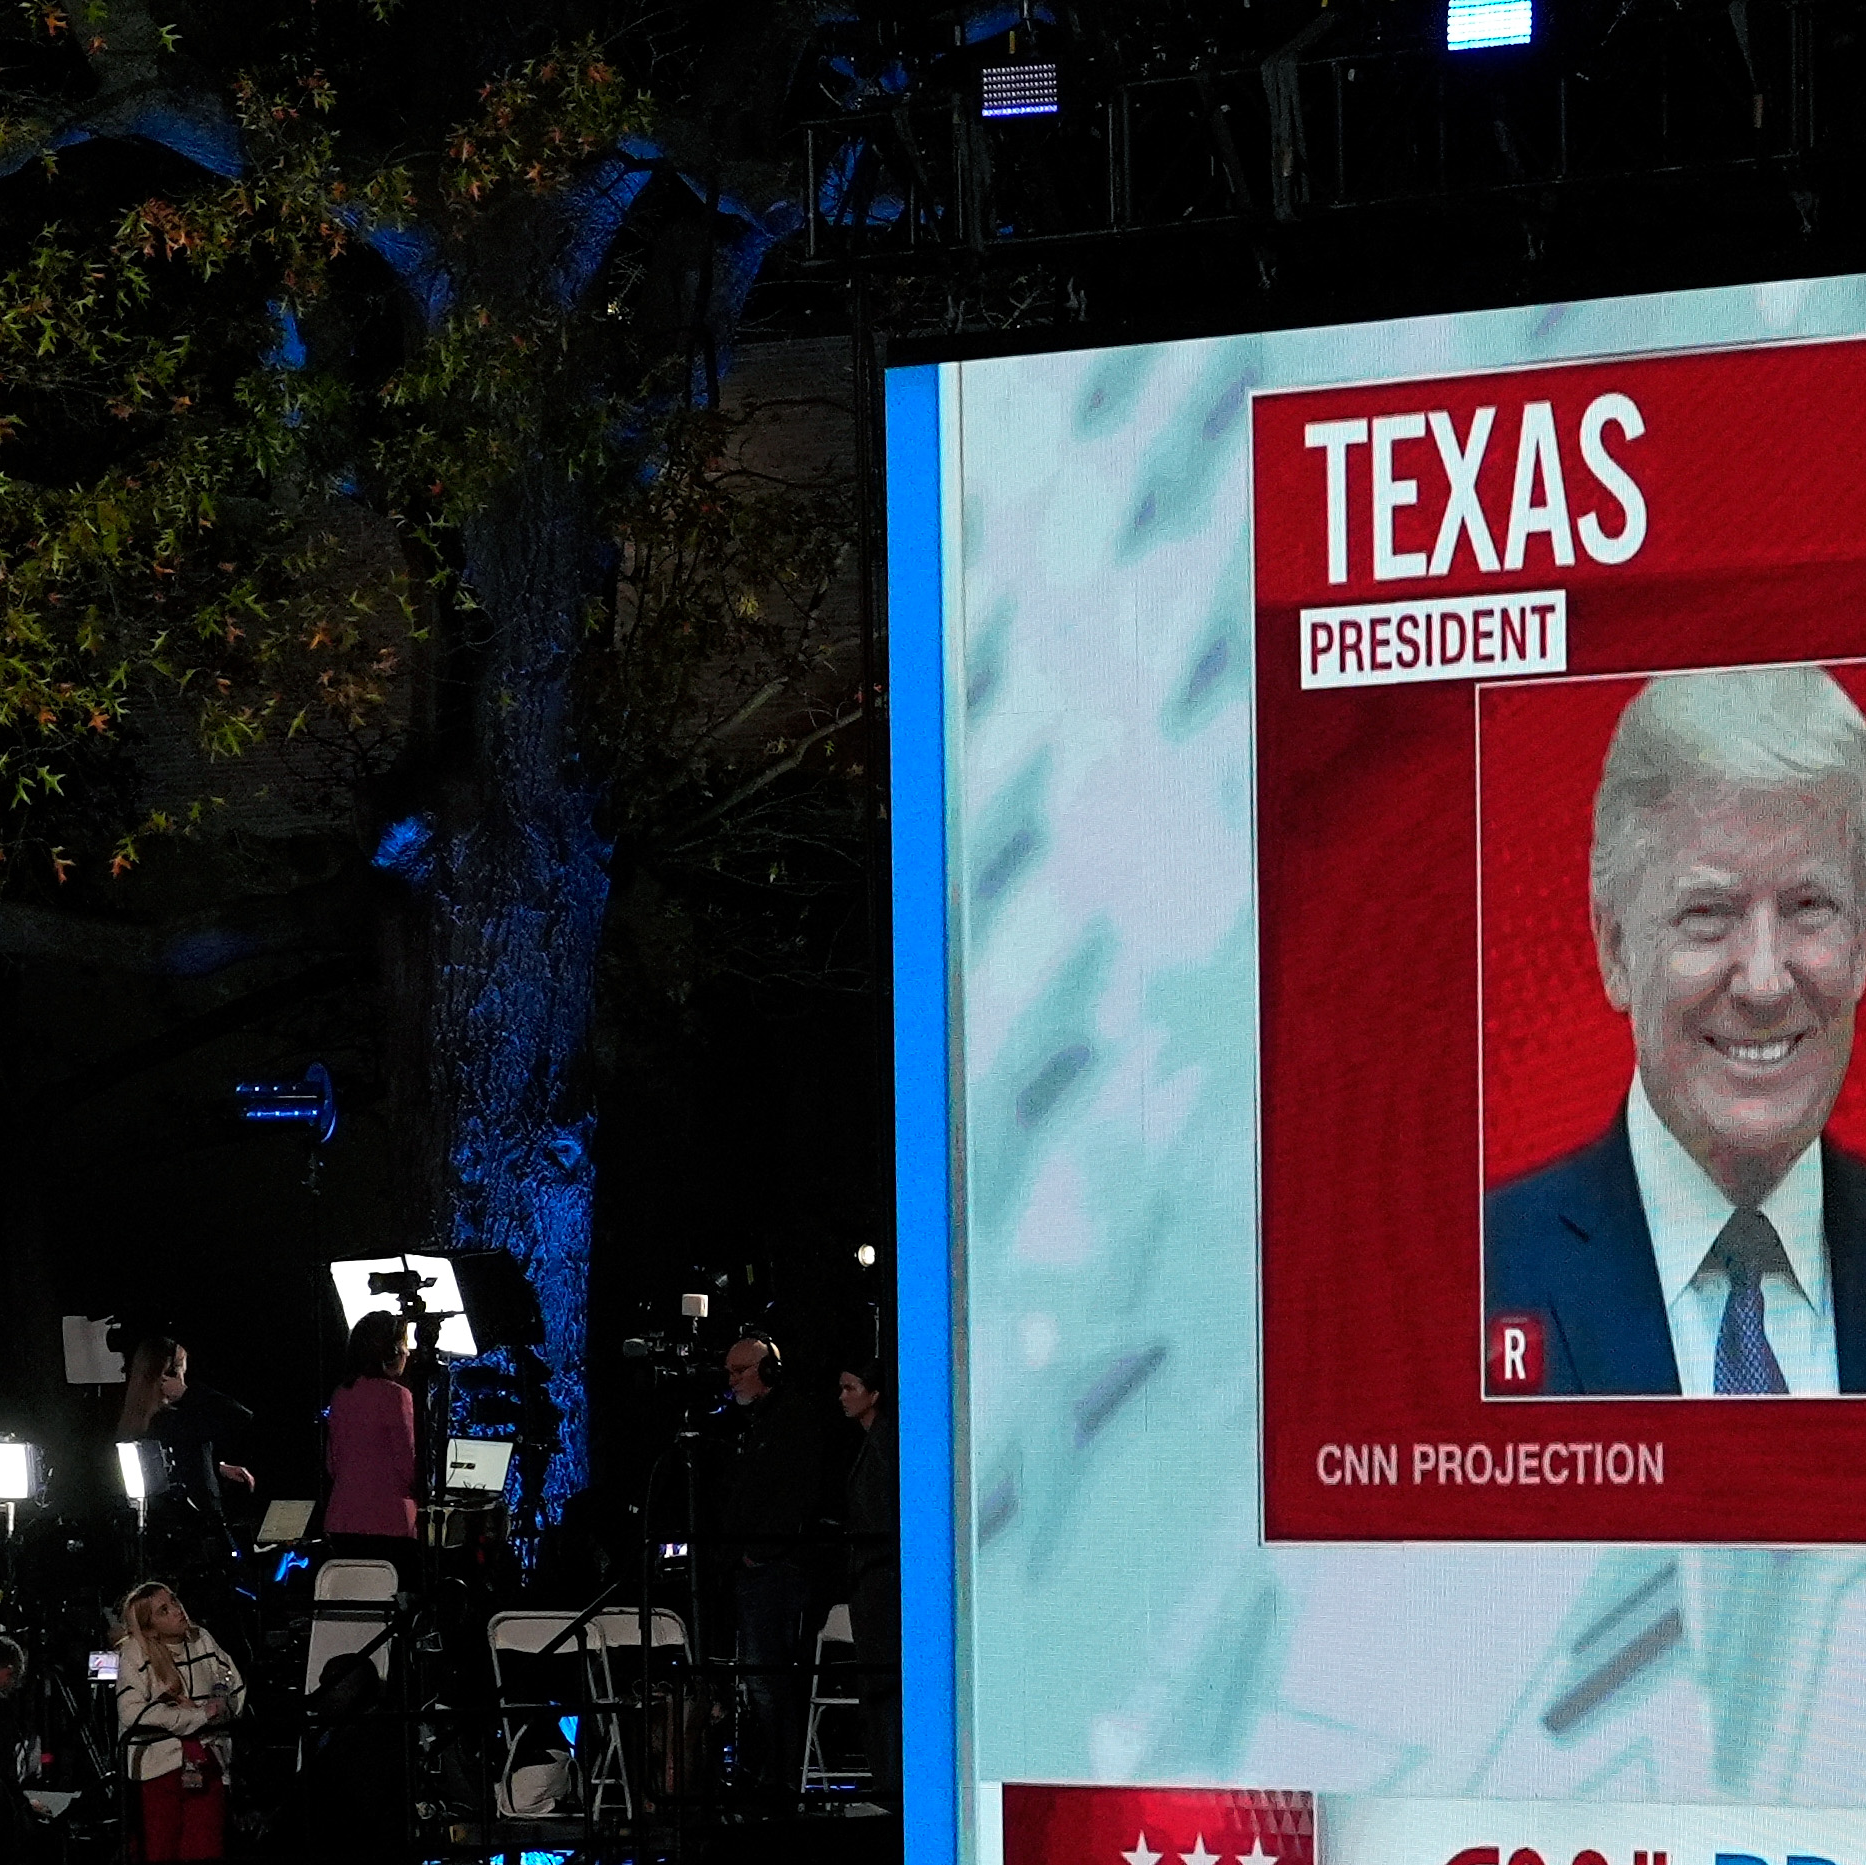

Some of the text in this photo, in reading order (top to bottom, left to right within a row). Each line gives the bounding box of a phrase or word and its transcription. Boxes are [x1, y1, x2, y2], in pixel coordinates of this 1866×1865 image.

[1304, 392, 1648, 584] TEXAS
[1310, 604, 1556, 675] PRESIDENT
[1503, 1327, 1526, 1380] R
[1316, 1441, 1665, 1486] CNN PROJECTION
